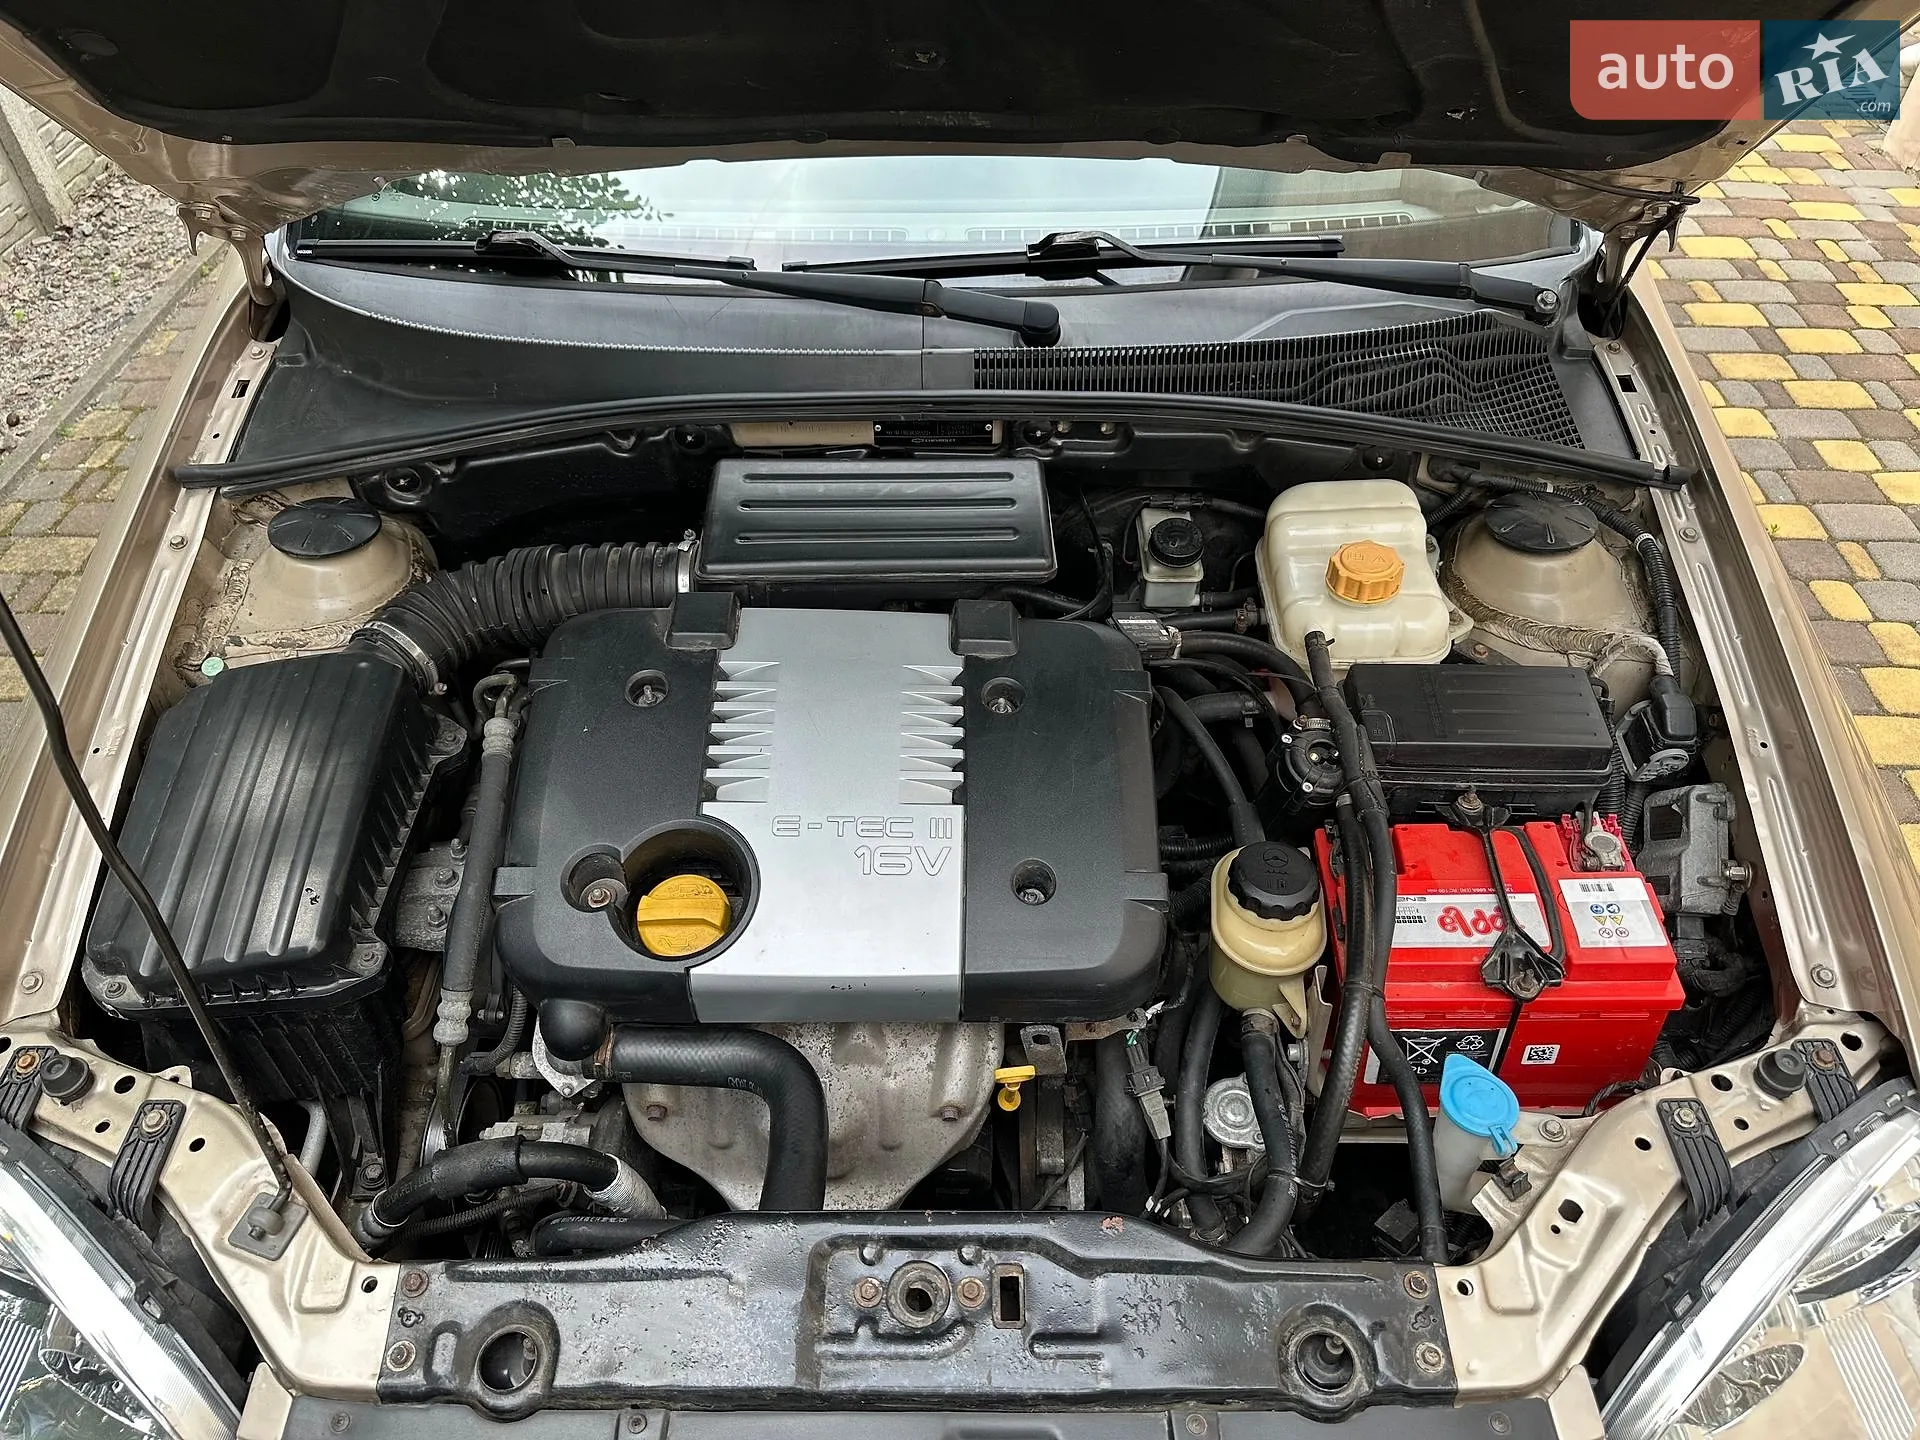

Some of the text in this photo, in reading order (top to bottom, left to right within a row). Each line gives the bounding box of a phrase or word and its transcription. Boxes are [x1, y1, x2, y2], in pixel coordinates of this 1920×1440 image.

[772, 815, 953, 839] E-TEC III
[854, 845, 951, 876] 16V
[1437, 905, 1525, 938] opla
